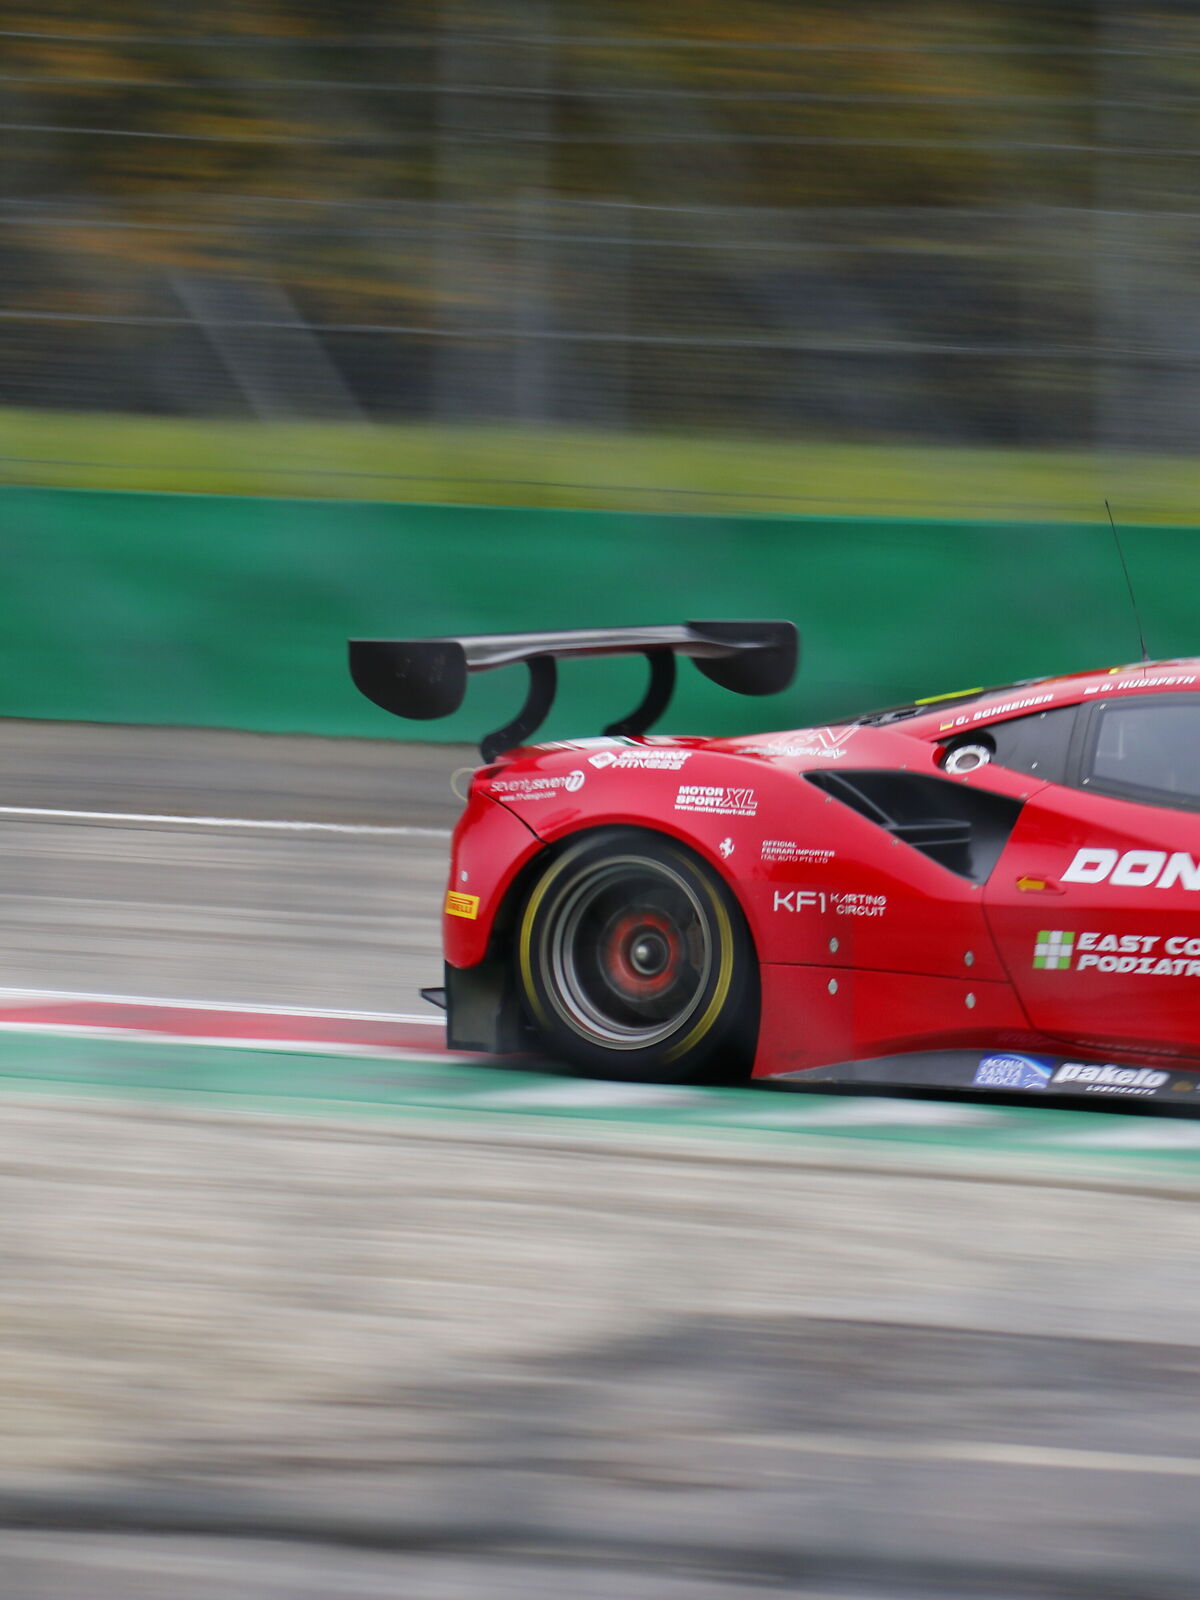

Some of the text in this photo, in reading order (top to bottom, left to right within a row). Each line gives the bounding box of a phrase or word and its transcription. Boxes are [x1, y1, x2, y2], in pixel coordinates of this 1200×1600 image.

[678, 786, 724, 797] MOTOR
[675, 788, 758, 809] SPORT XL
[762, 840, 797, 848] OFFICIAL
[761, 847, 835, 857] FERRARI IMPORTER
[777, 855, 798, 863] AUTO
[773, 890, 826, 913] KF1
[830, 893, 887, 906] KARTING
[836, 905, 887, 917] CIRCUIT
[1076, 931, 1161, 954] EAST
[1052, 1061, 1171, 1088] pakelo
